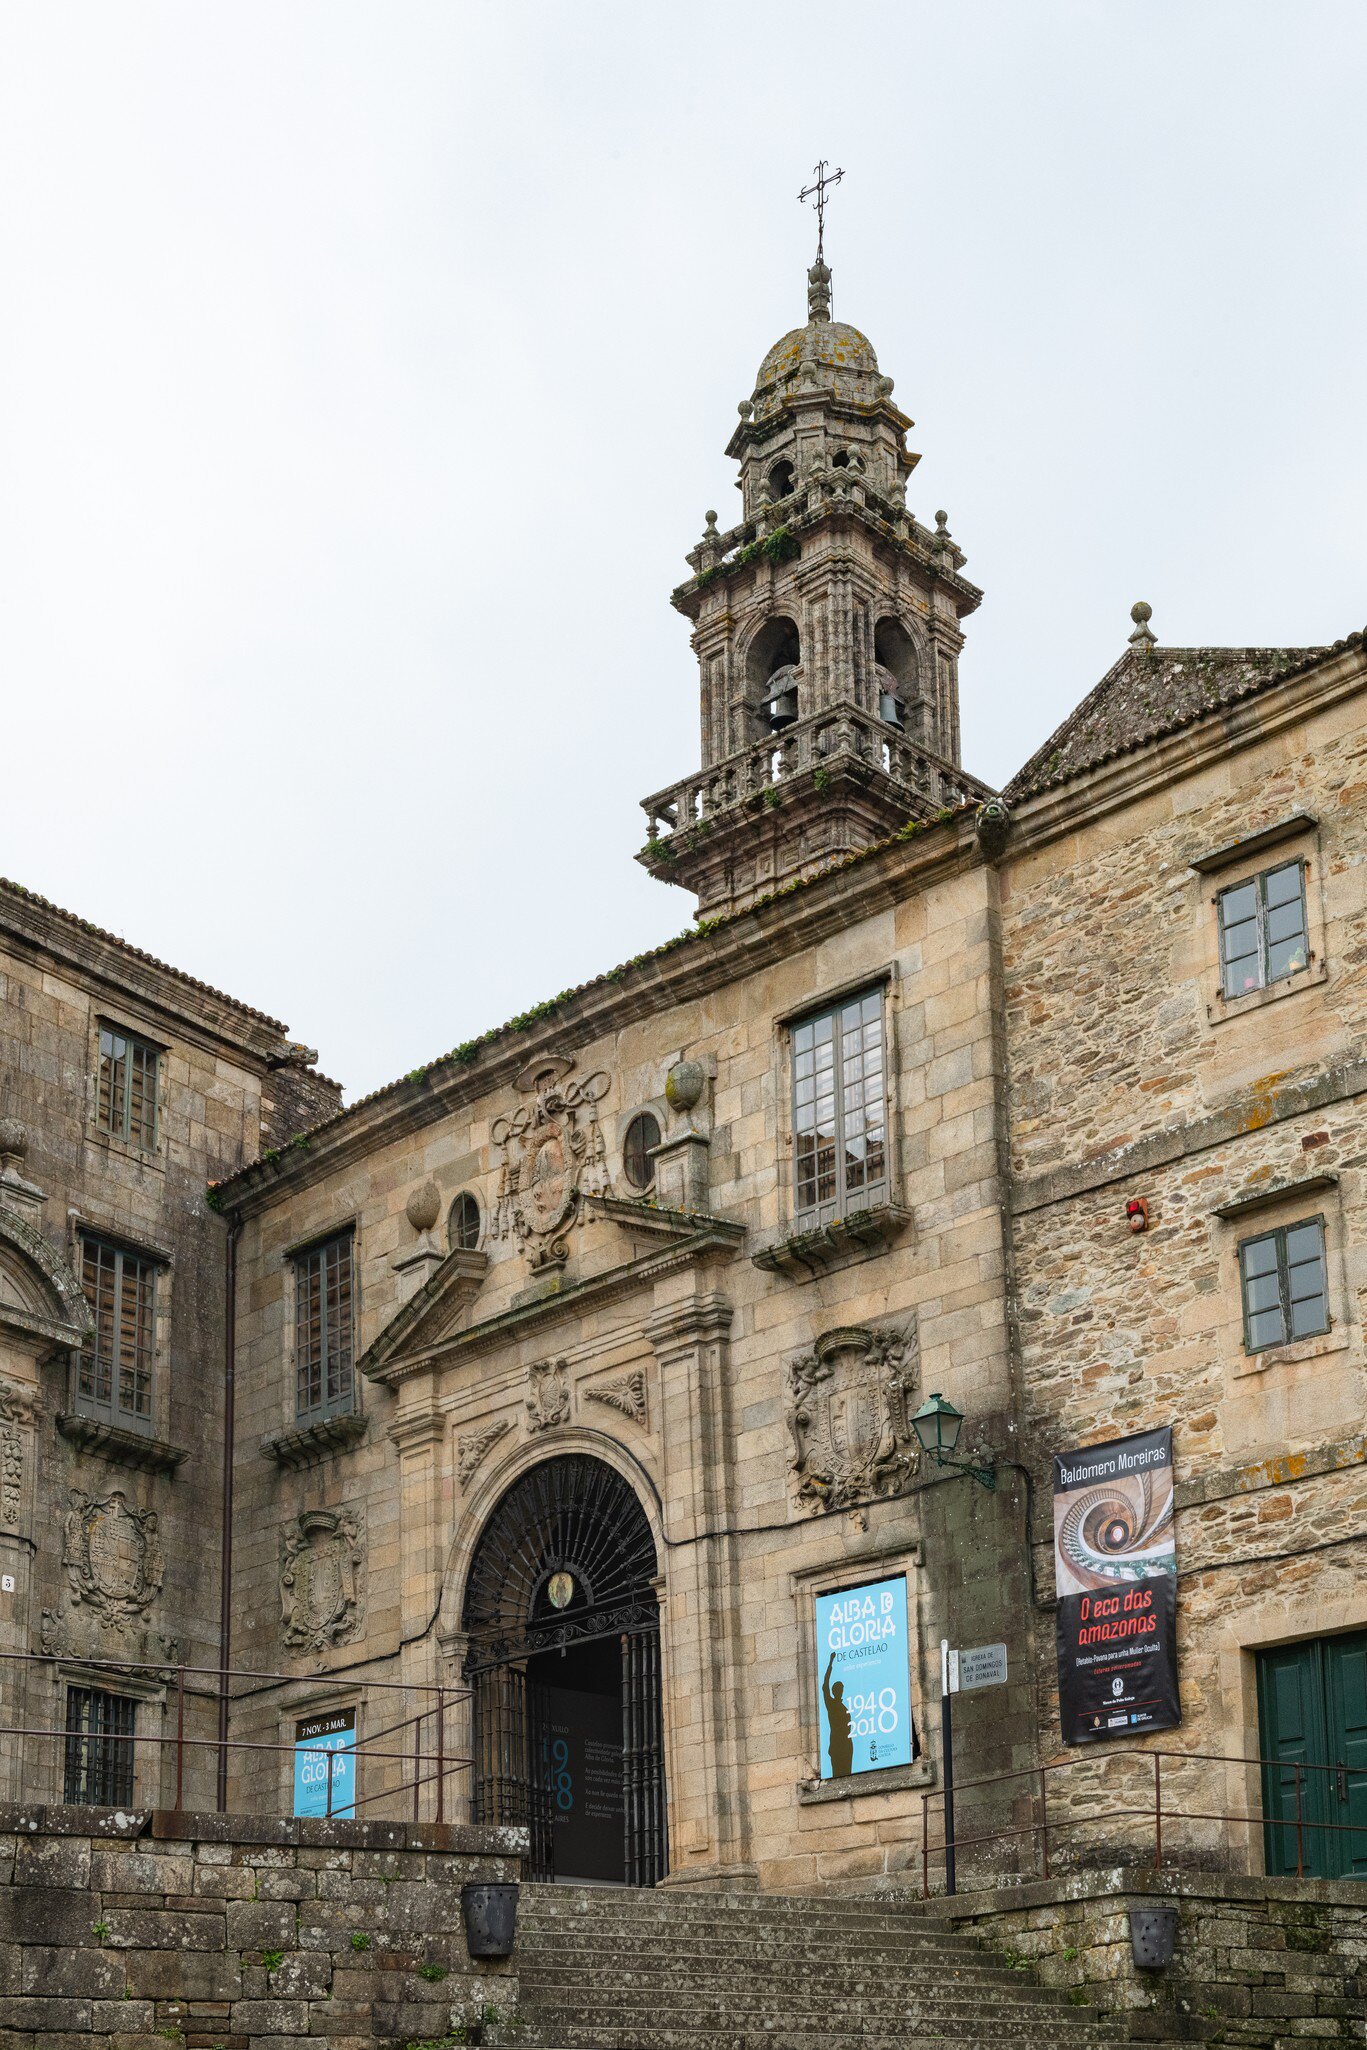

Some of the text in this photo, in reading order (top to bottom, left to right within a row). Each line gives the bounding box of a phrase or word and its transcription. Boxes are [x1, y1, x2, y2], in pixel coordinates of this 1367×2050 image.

[1060, 1447, 1166, 1485] Baldomero Moreiras
[829, 1595, 876, 1626] ALBA
[1080, 1589, 1153, 1621] O eco das
[828, 1614, 896, 1650] GLORIA
[1078, 1614, 1157, 1646] amazonas
[836, 1642, 888, 1662] DE CASTELAO
[987, 1651, 994, 1659] DE
[963, 1659, 1003, 1674] SAN DOMINGOS
[965, 1669, 1000, 1683] DE BONAVAL
[301, 1728, 306, 1737] 7
[306, 1725, 321, 1736] NOV.
[325, 1722, 330, 1731] 3
[330, 1718, 347, 1730] MAR.
[306, 1785, 314, 1795] DE
